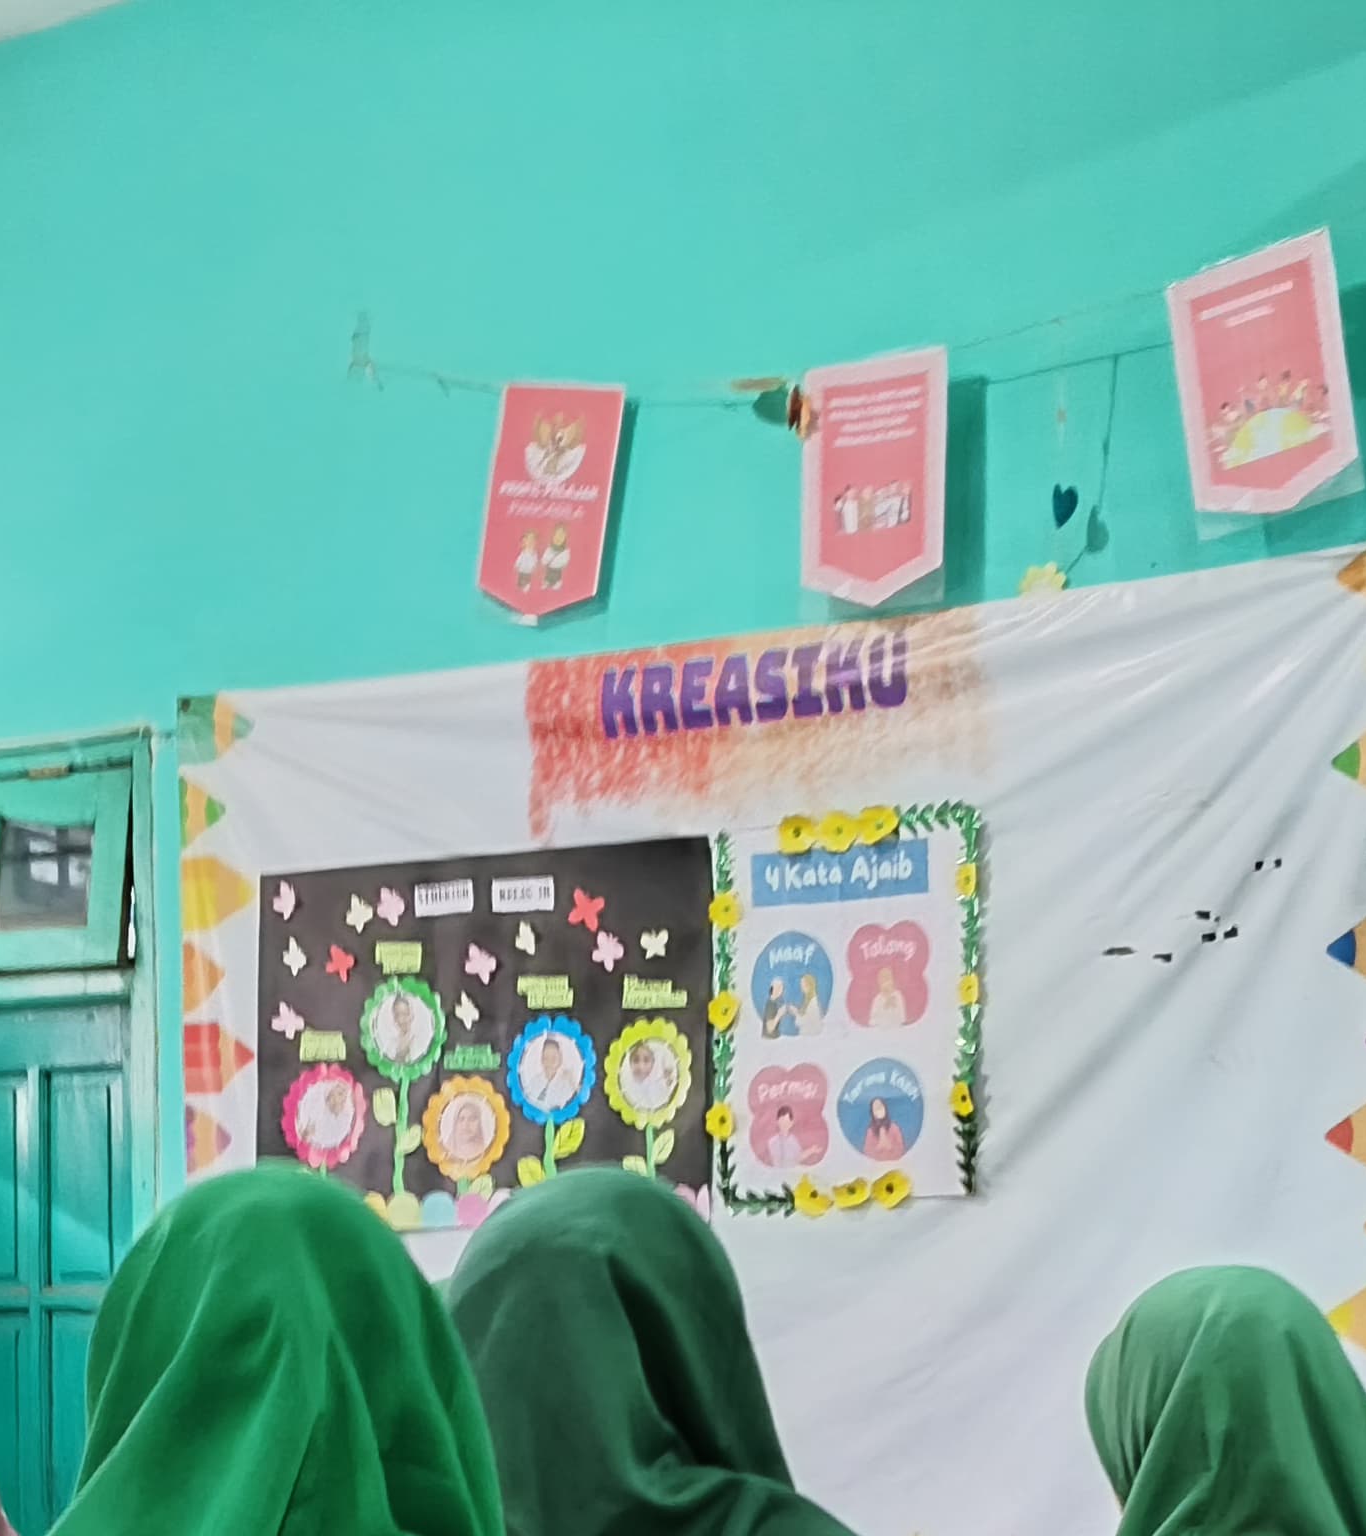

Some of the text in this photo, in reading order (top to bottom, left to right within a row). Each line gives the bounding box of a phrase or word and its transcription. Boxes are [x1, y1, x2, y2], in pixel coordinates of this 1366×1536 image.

[601, 631, 909, 740] KREASIKU
[765, 849, 913, 892] 4 Kata Ajaib
[769, 943, 816, 969] Maaf
[859, 936, 917, 961] Tolong
